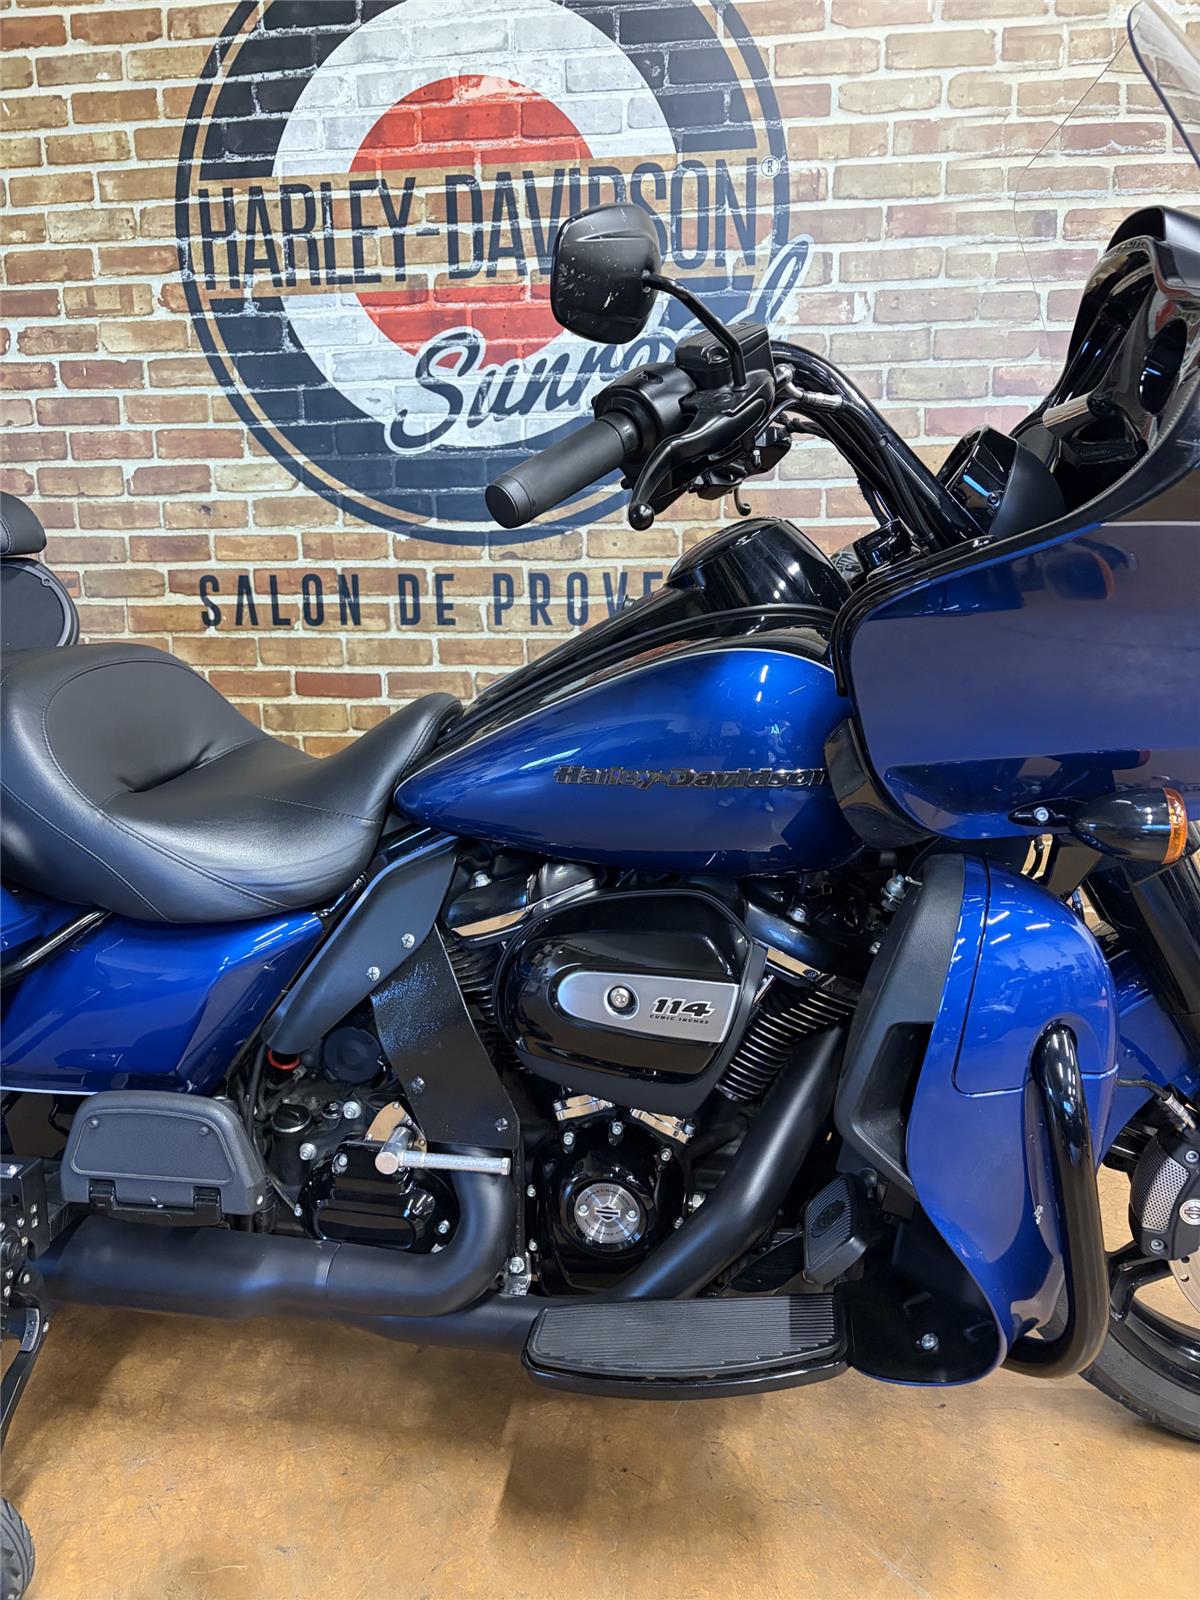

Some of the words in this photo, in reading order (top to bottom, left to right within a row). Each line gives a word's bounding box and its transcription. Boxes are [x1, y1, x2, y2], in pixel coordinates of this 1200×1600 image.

[199, 573, 361, 627] SALON
[398, 573, 456, 626] DE
[553, 765, 829, 789] Harley-Davidson
[652, 997, 716, 1018] 114
[678, 1017, 709, 1025] INCHES
